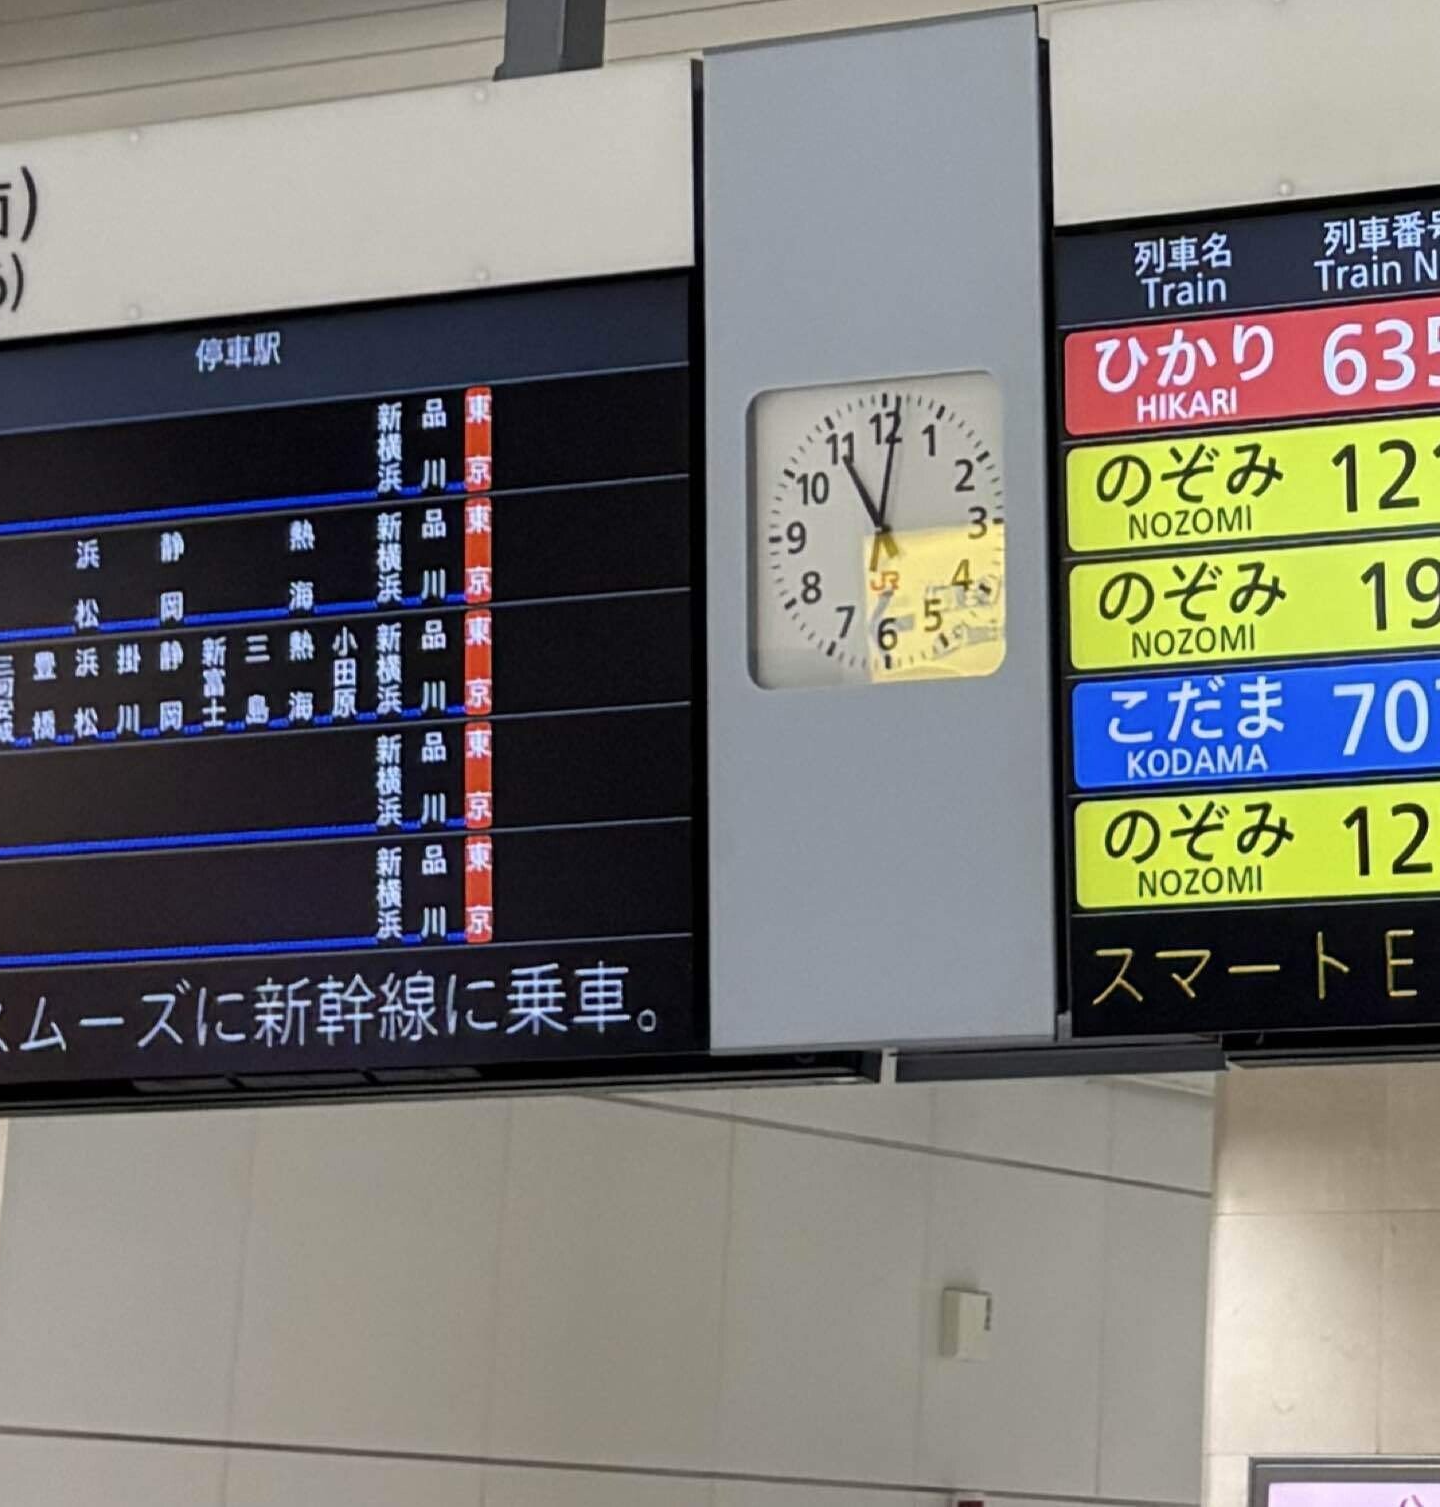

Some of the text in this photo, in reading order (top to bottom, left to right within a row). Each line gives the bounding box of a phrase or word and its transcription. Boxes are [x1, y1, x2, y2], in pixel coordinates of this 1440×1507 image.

[1134, 232, 1233, 276] 列車名
[1140, 274, 1227, 310] Train
[1314, 257, 1402, 293] Train
[196, 331, 281, 372] 停車駅
[1094, 322, 1274, 394] ひかり
[1136, 387, 1238, 424] HIKARI
[922, 423, 936, 457] 1
[796, 471, 829, 506] 10
[954, 458, 976, 493] 2
[1096, 441, 1284, 509] のぞみ
[786, 521, 806, 555] 9
[967, 506, 988, 540] 3
[1128, 505, 1252, 541] NOZOMI
[800, 570, 822, 604] 8
[1098, 559, 1287, 626] のぞみ
[835, 606, 856, 638] 7
[1131, 624, 1256, 659] NOZOMI
[1106, 675, 1285, 745] こだま
[1126, 743, 1269, 781] KODAMA
[1103, 799, 1295, 866] のぞみ
[1137, 863, 1264, 898] NOZOMI
